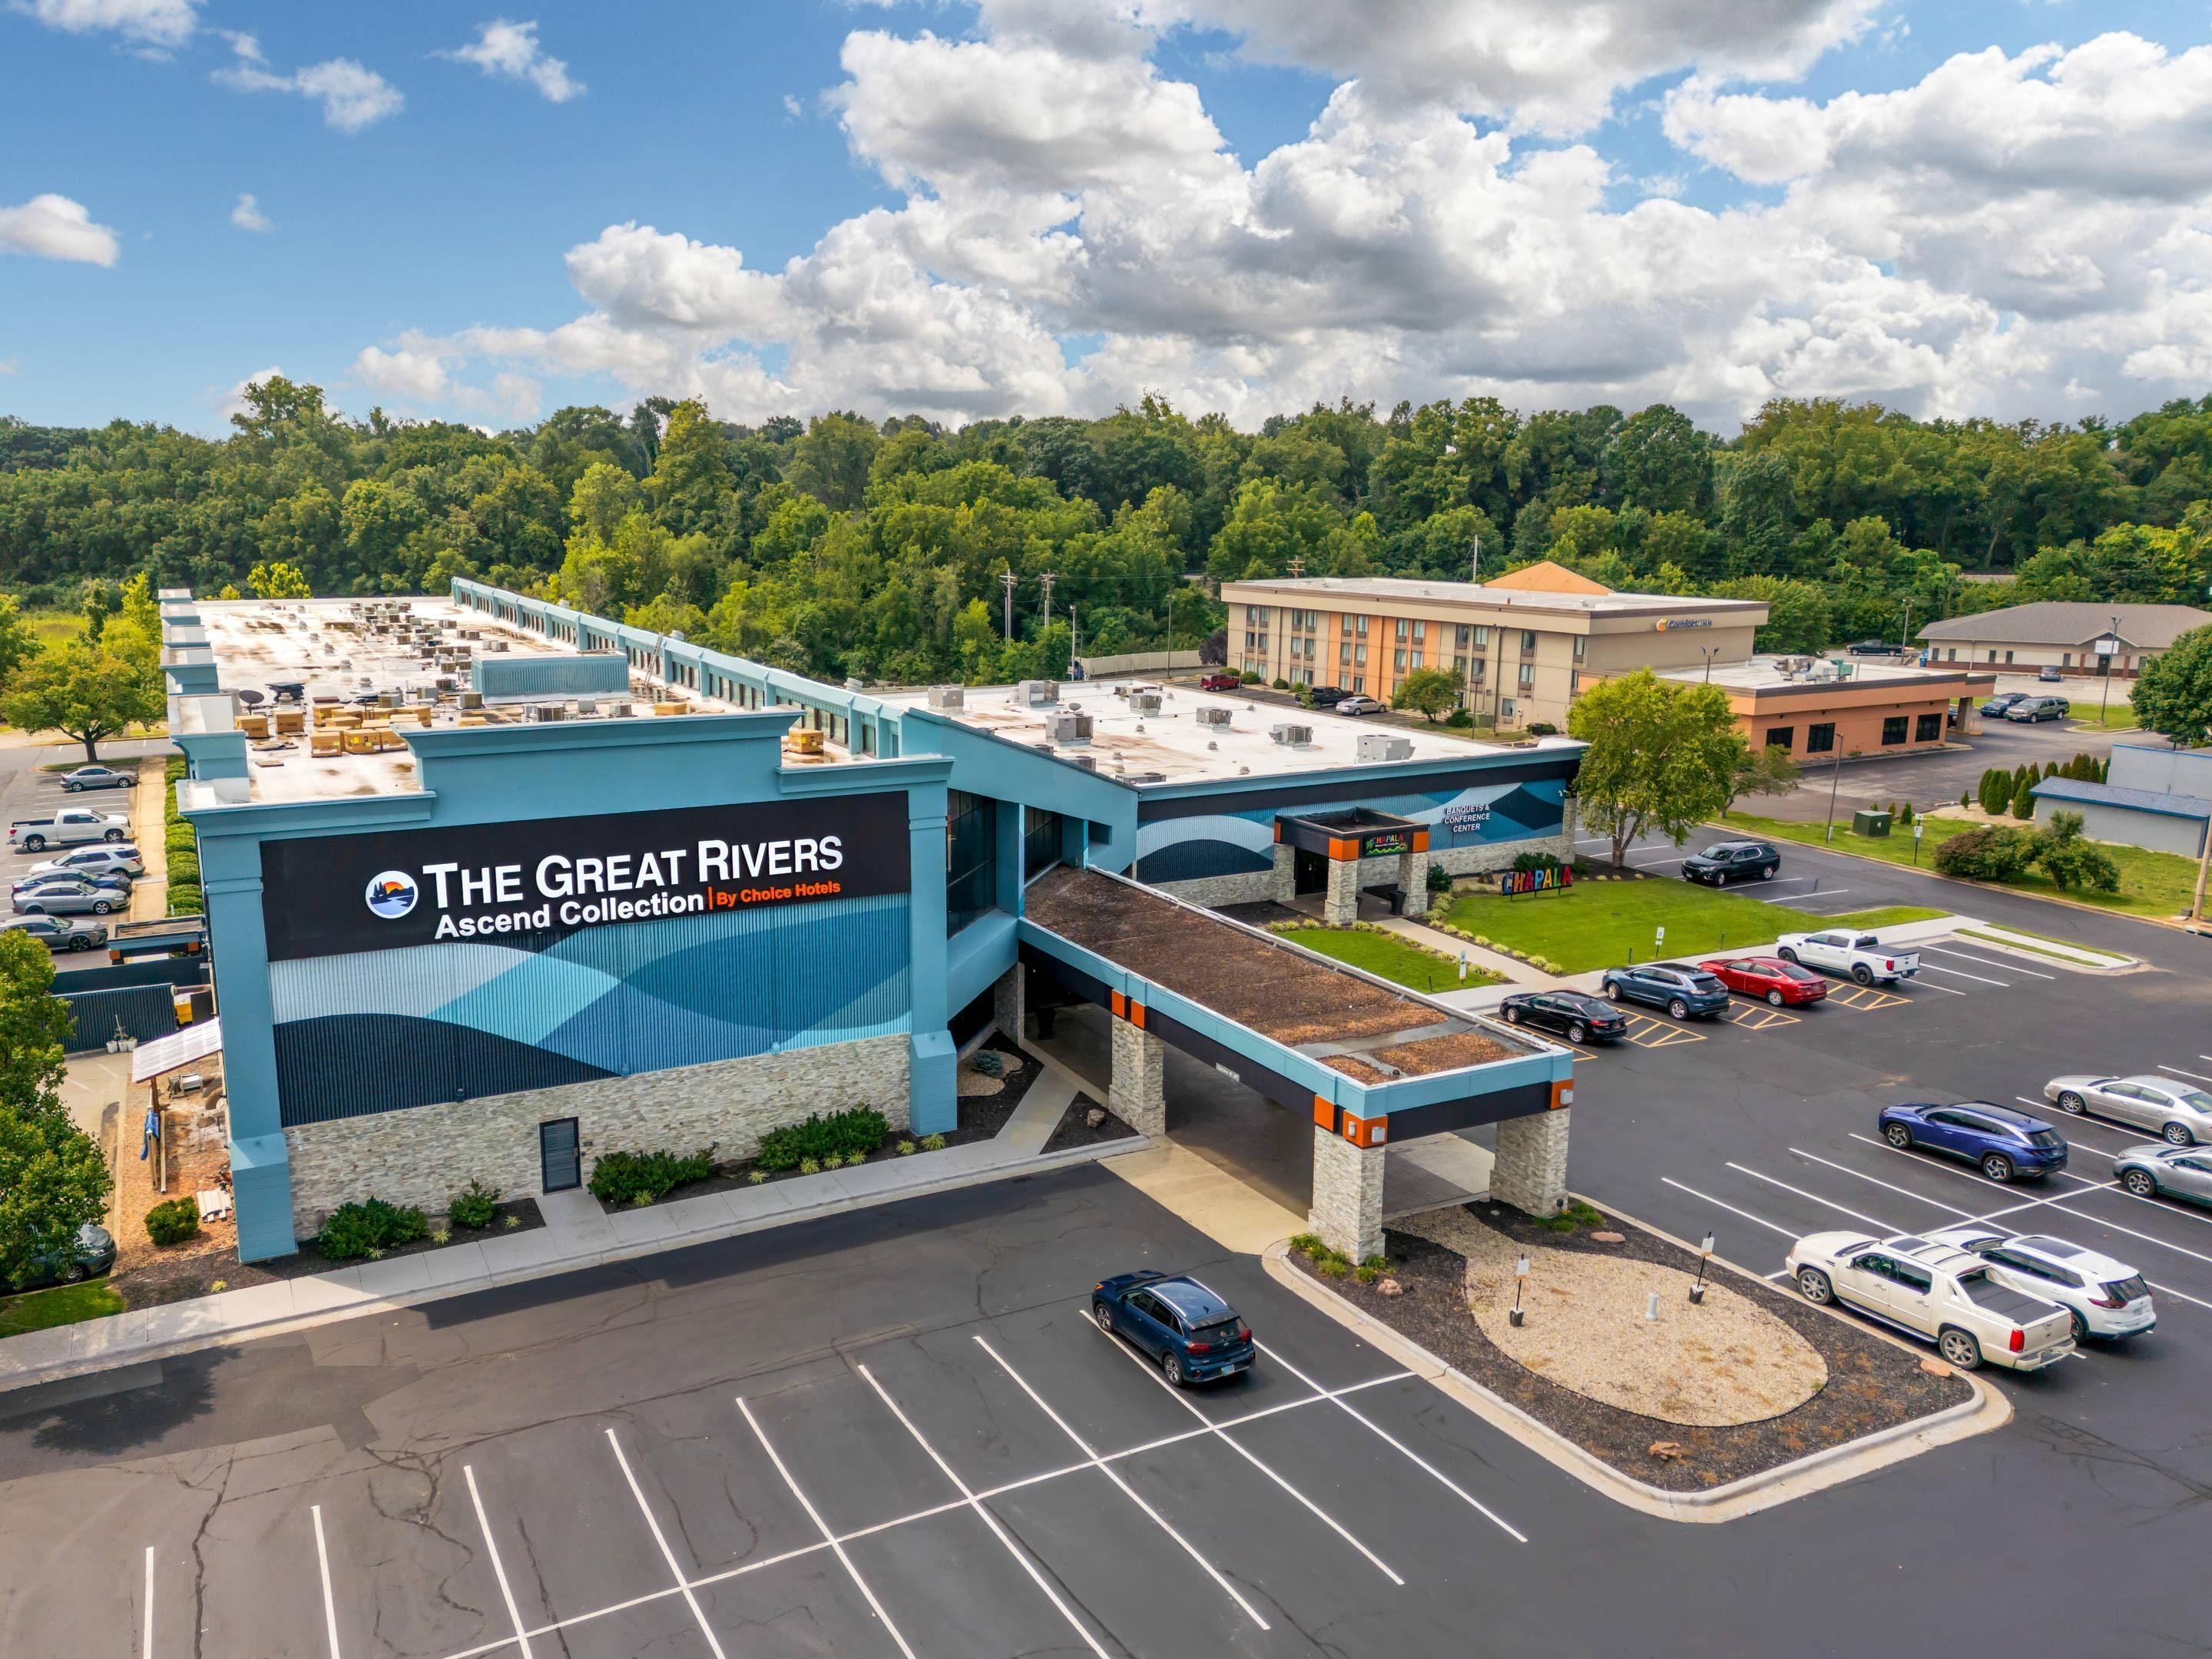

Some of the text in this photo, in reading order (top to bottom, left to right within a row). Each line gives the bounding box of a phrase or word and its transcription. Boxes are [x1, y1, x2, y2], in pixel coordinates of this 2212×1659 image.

[1444, 813, 1491, 824] CONFERENCE
[1446, 804, 1484, 815] BANQUETS
[1452, 823, 1481, 833] CENTER
[1372, 834, 1405, 844] CHAPALA
[422, 835, 843, 909] THE GREAT RIVERS
[1502, 865, 1572, 894] CHAPALA
[716, 881, 842, 907] By Choice Hotels
[434, 892, 704, 939] Ascend Collection
